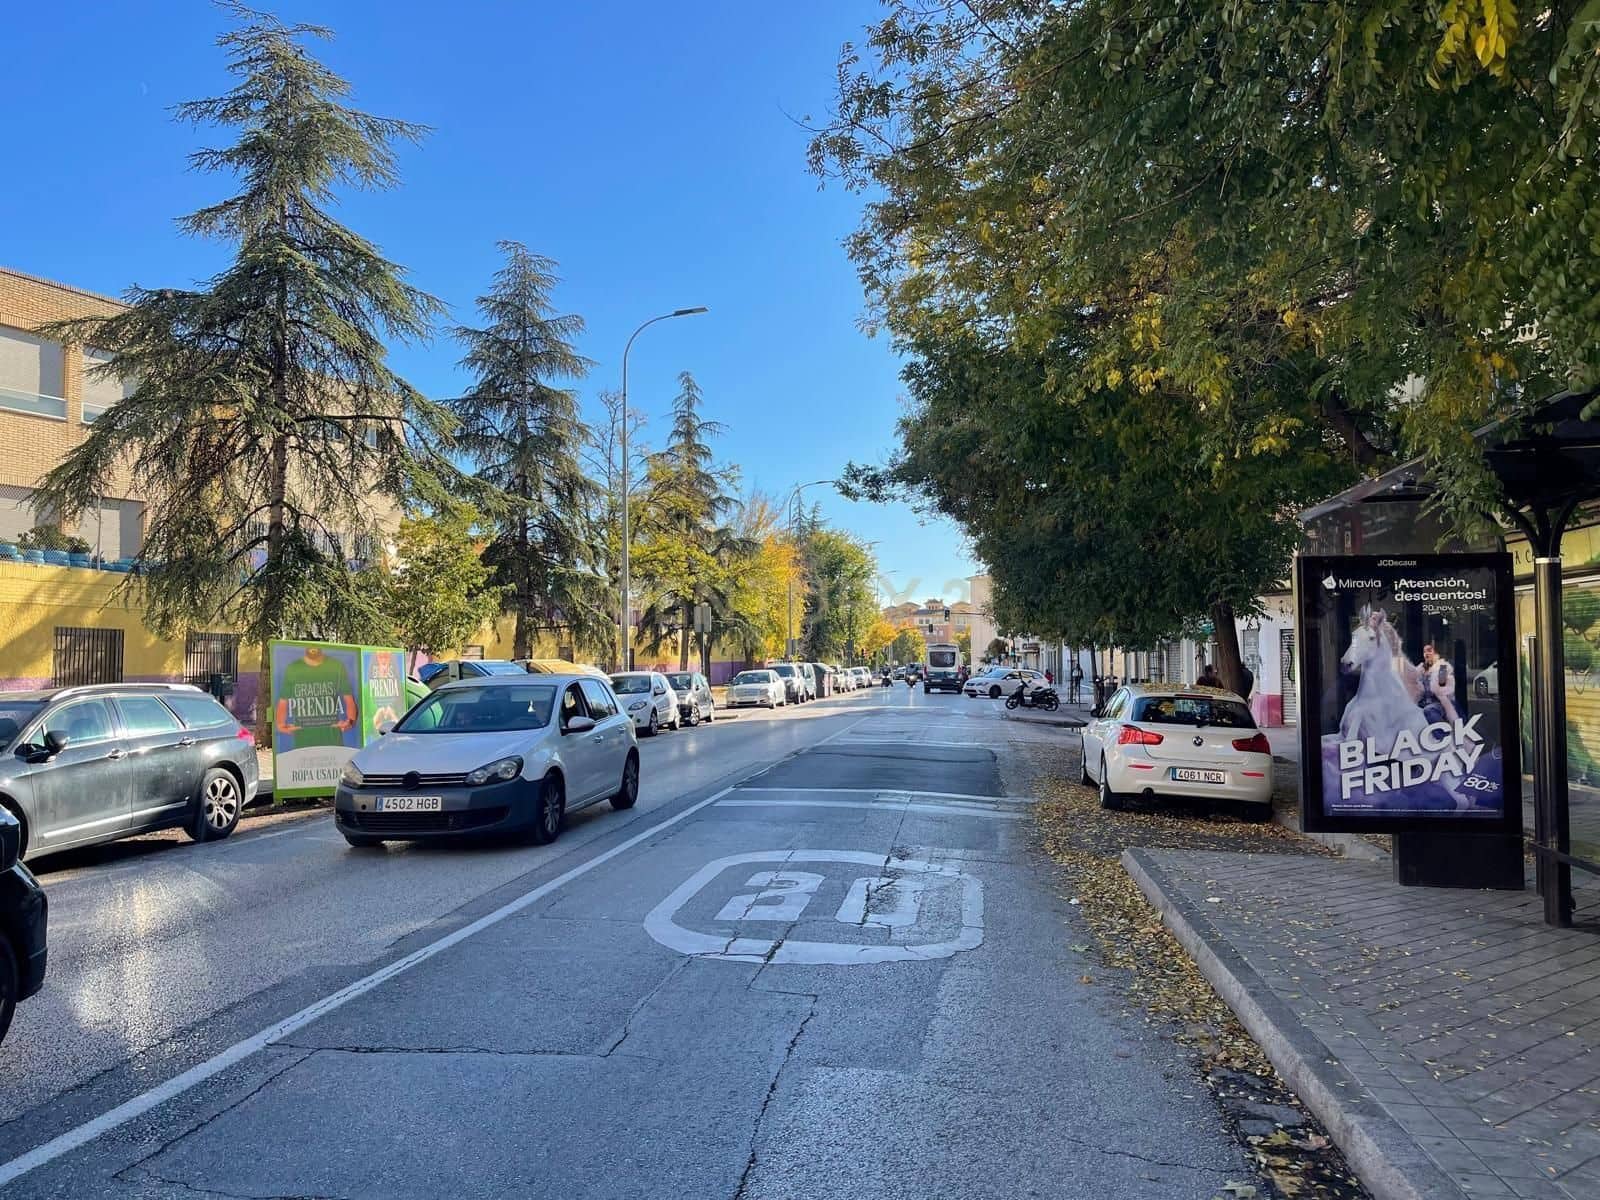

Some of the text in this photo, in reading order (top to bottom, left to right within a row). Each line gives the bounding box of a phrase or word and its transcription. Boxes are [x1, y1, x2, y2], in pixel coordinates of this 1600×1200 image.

[1338, 578, 1382, 589] Miravia
[1394, 577, 1470, 590] ¡Atención,
[1394, 589, 1487, 602] descuentos!
[370, 679, 400, 697] PRENDA
[288, 695, 345, 718] PRENDA
[1339, 713, 1484, 770] BLACK
[292, 770, 314, 783] ROPA
[1178, 770, 1223, 782] 4061 NCR
[1341, 743, 1485, 800] FRIDAY
[385, 798, 439, 810] 4502 HGB
